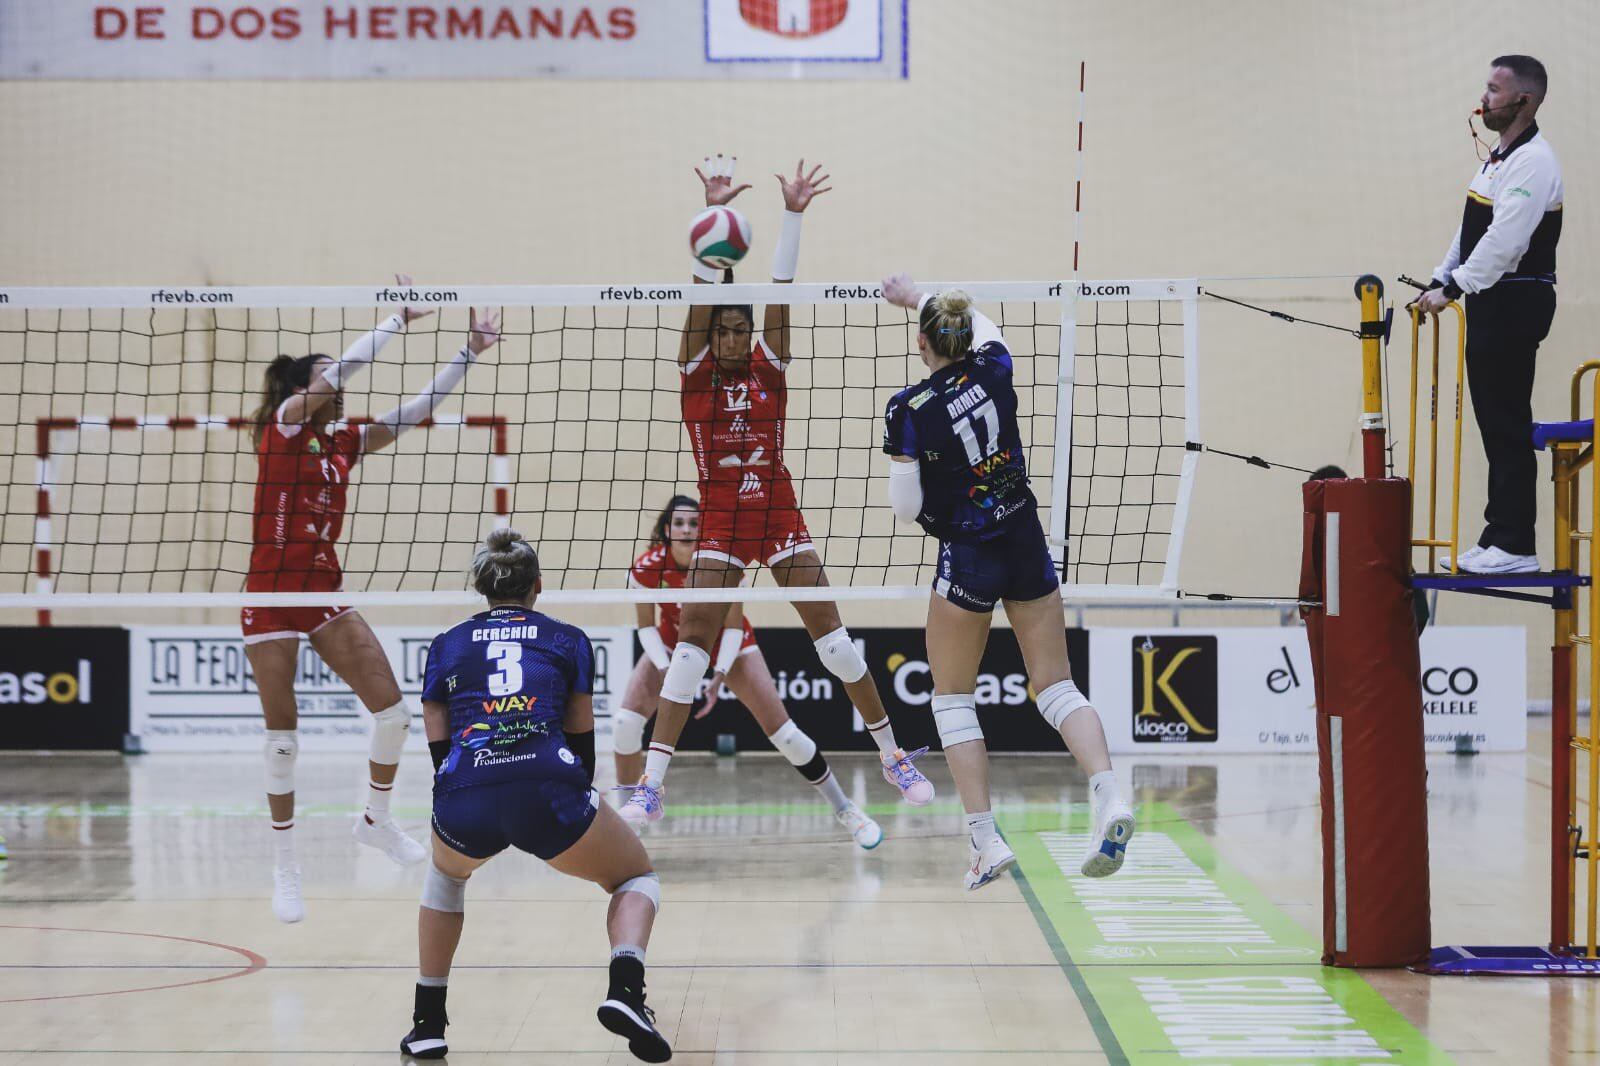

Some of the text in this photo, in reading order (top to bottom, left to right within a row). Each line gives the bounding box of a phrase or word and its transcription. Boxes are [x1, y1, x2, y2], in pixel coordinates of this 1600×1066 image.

[93, 6, 638, 40] DE DOS HERMANAS
[151, 288, 234, 303] rfevb.com
[376, 287, 458, 303] rfevb.com
[600, 286, 682, 300] rfevb.com
[824, 285, 885, 299] rfevb.c
[1049, 283, 1130, 296] rfb.com
[723, 383, 751, 406] 12
[952, 399, 1000, 466] 17
[472, 626, 538, 642] CERCHIO
[486, 641, 523, 696] 3
[1266, 646, 1300, 694] el
[0, 658, 91, 704] asol
[482, 695, 537, 714] WAY
[1423, 701, 1478, 715] KELELE
[1135, 713, 1189, 736] kiosco
[1130, 976, 1393, 1058] DEPORTES
